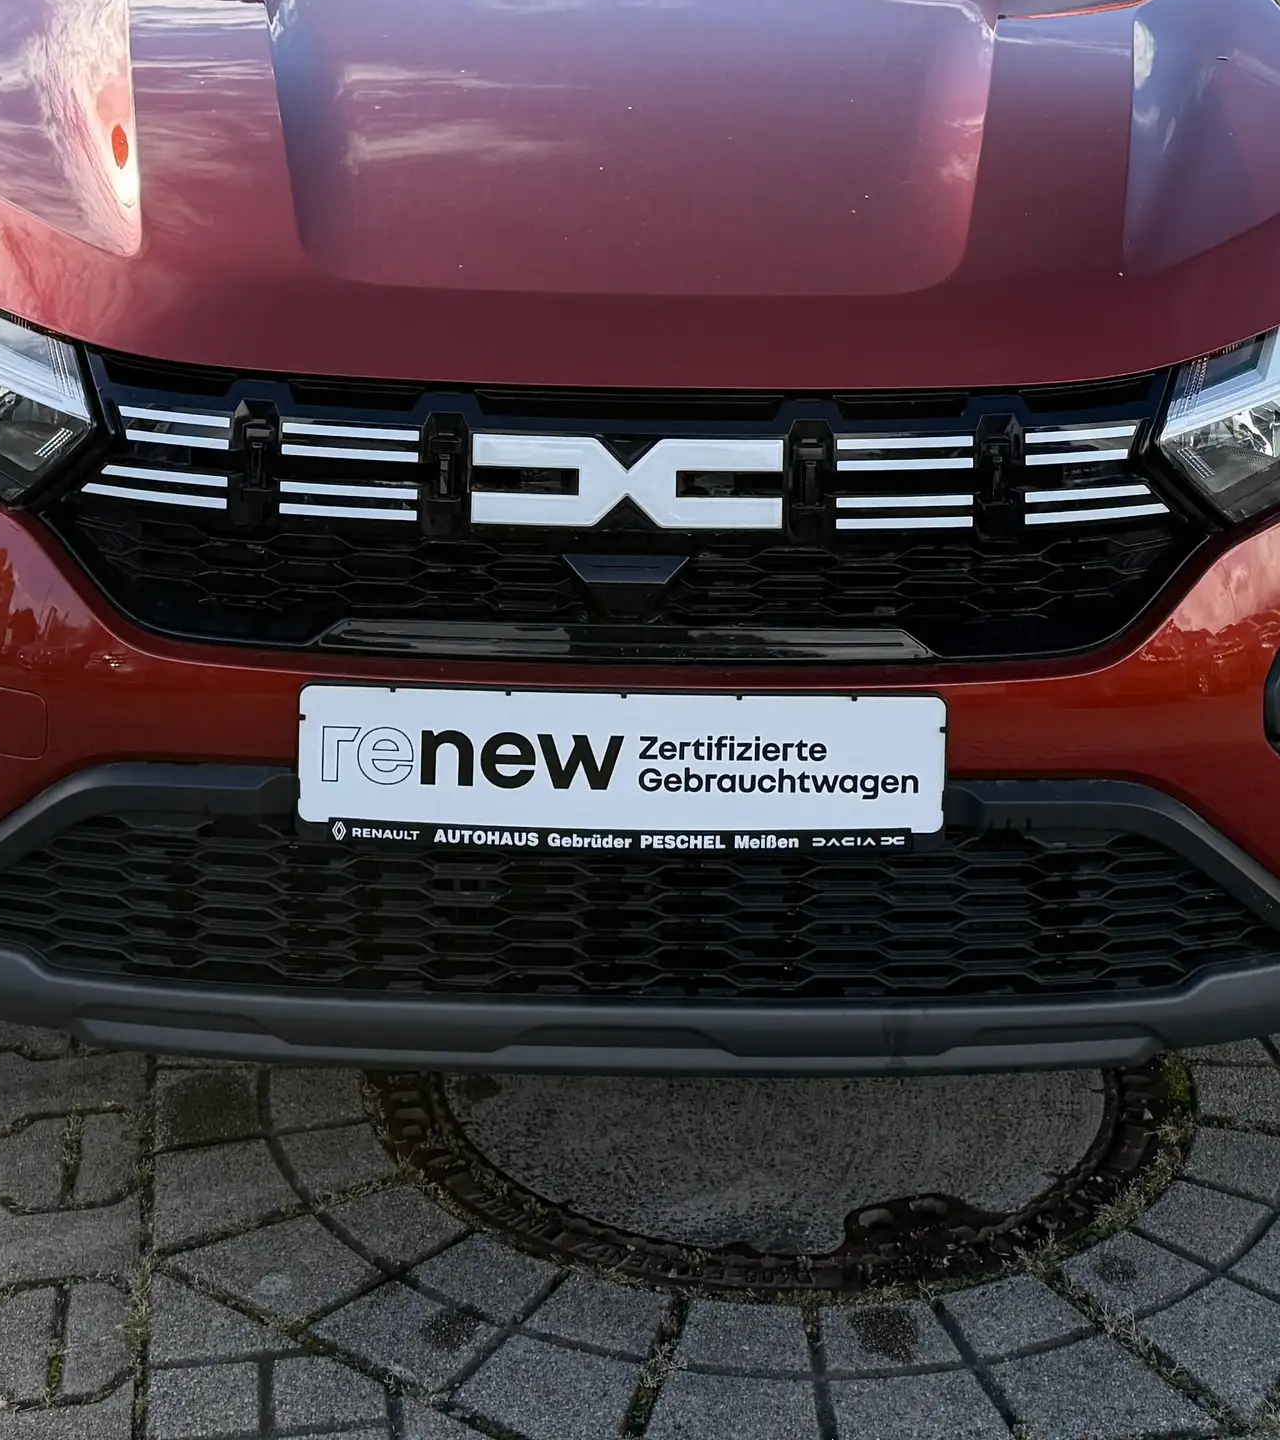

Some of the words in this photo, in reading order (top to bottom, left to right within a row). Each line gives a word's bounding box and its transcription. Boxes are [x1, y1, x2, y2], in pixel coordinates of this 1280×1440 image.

[321, 725, 625, 790] renew
[638, 735, 828, 762] Zertifizierte
[637, 767, 920, 800] Gebrauchtwagen
[352, 826, 421, 841] RENAULT
[433, 828, 540, 847] AUTOHAUS
[547, 831, 633, 849] Gebrüder
[640, 834, 726, 850] PESCHEL
[734, 833, 800, 849] Meißen
[812, 837, 877, 847] DACIA
